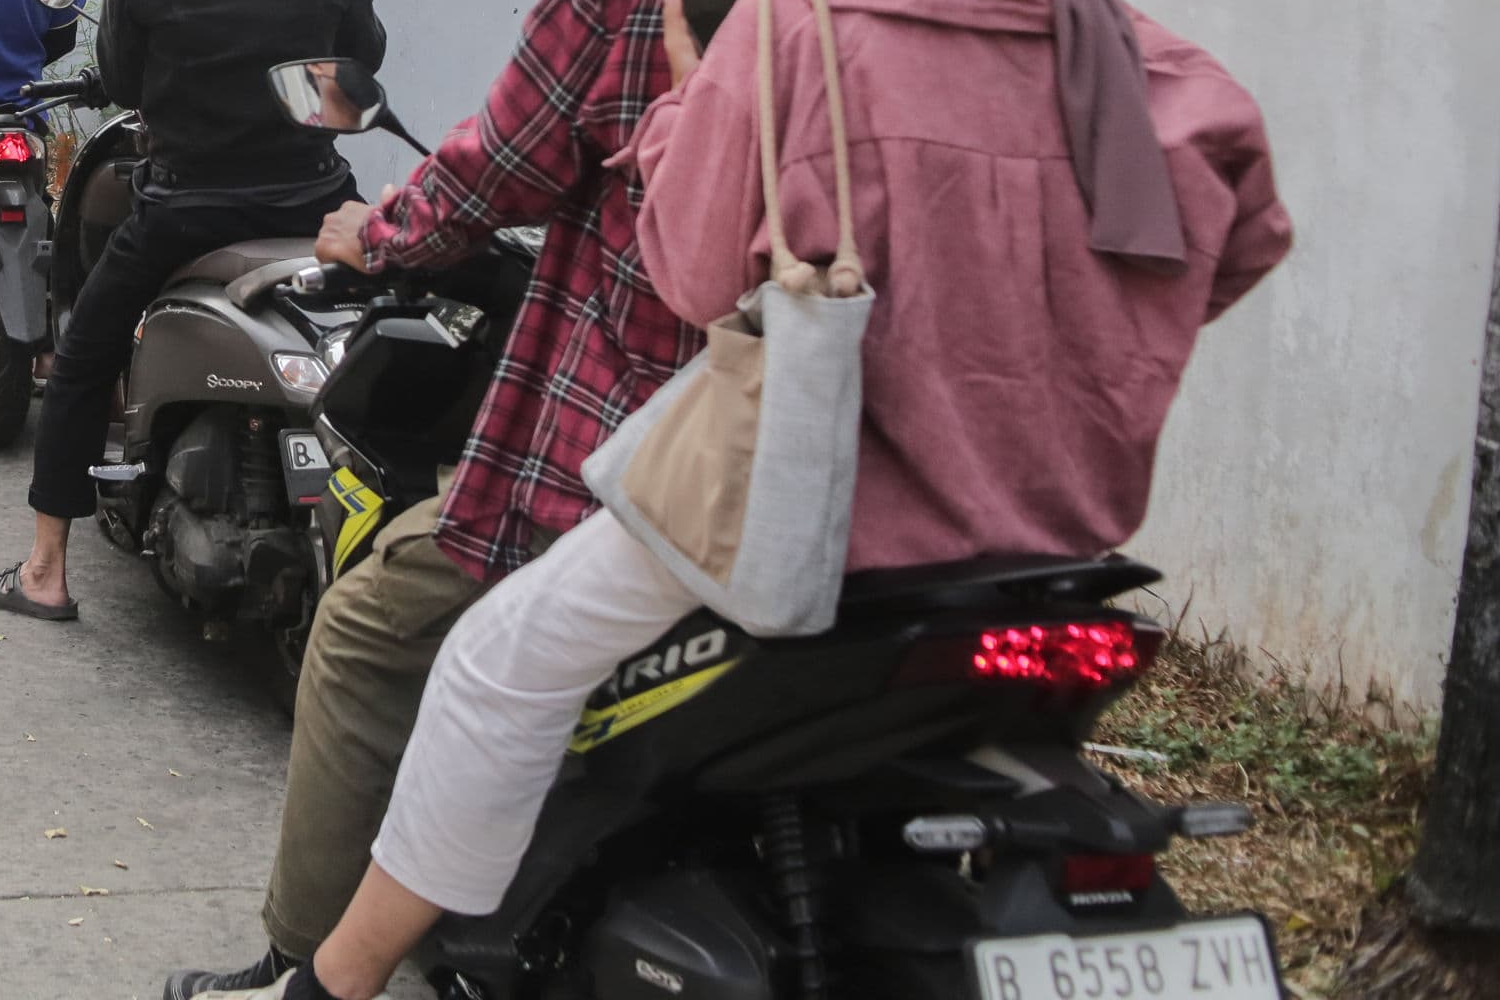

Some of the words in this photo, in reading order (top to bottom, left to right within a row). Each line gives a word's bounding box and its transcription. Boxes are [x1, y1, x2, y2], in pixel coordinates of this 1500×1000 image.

[607, 628, 727, 692] RIO
[1071, 890, 1133, 906] HONDA
[994, 955, 1021, 1000] B
[1049, 943, 1164, 1000] 6558
[1180, 935, 1267, 988] ZVH
